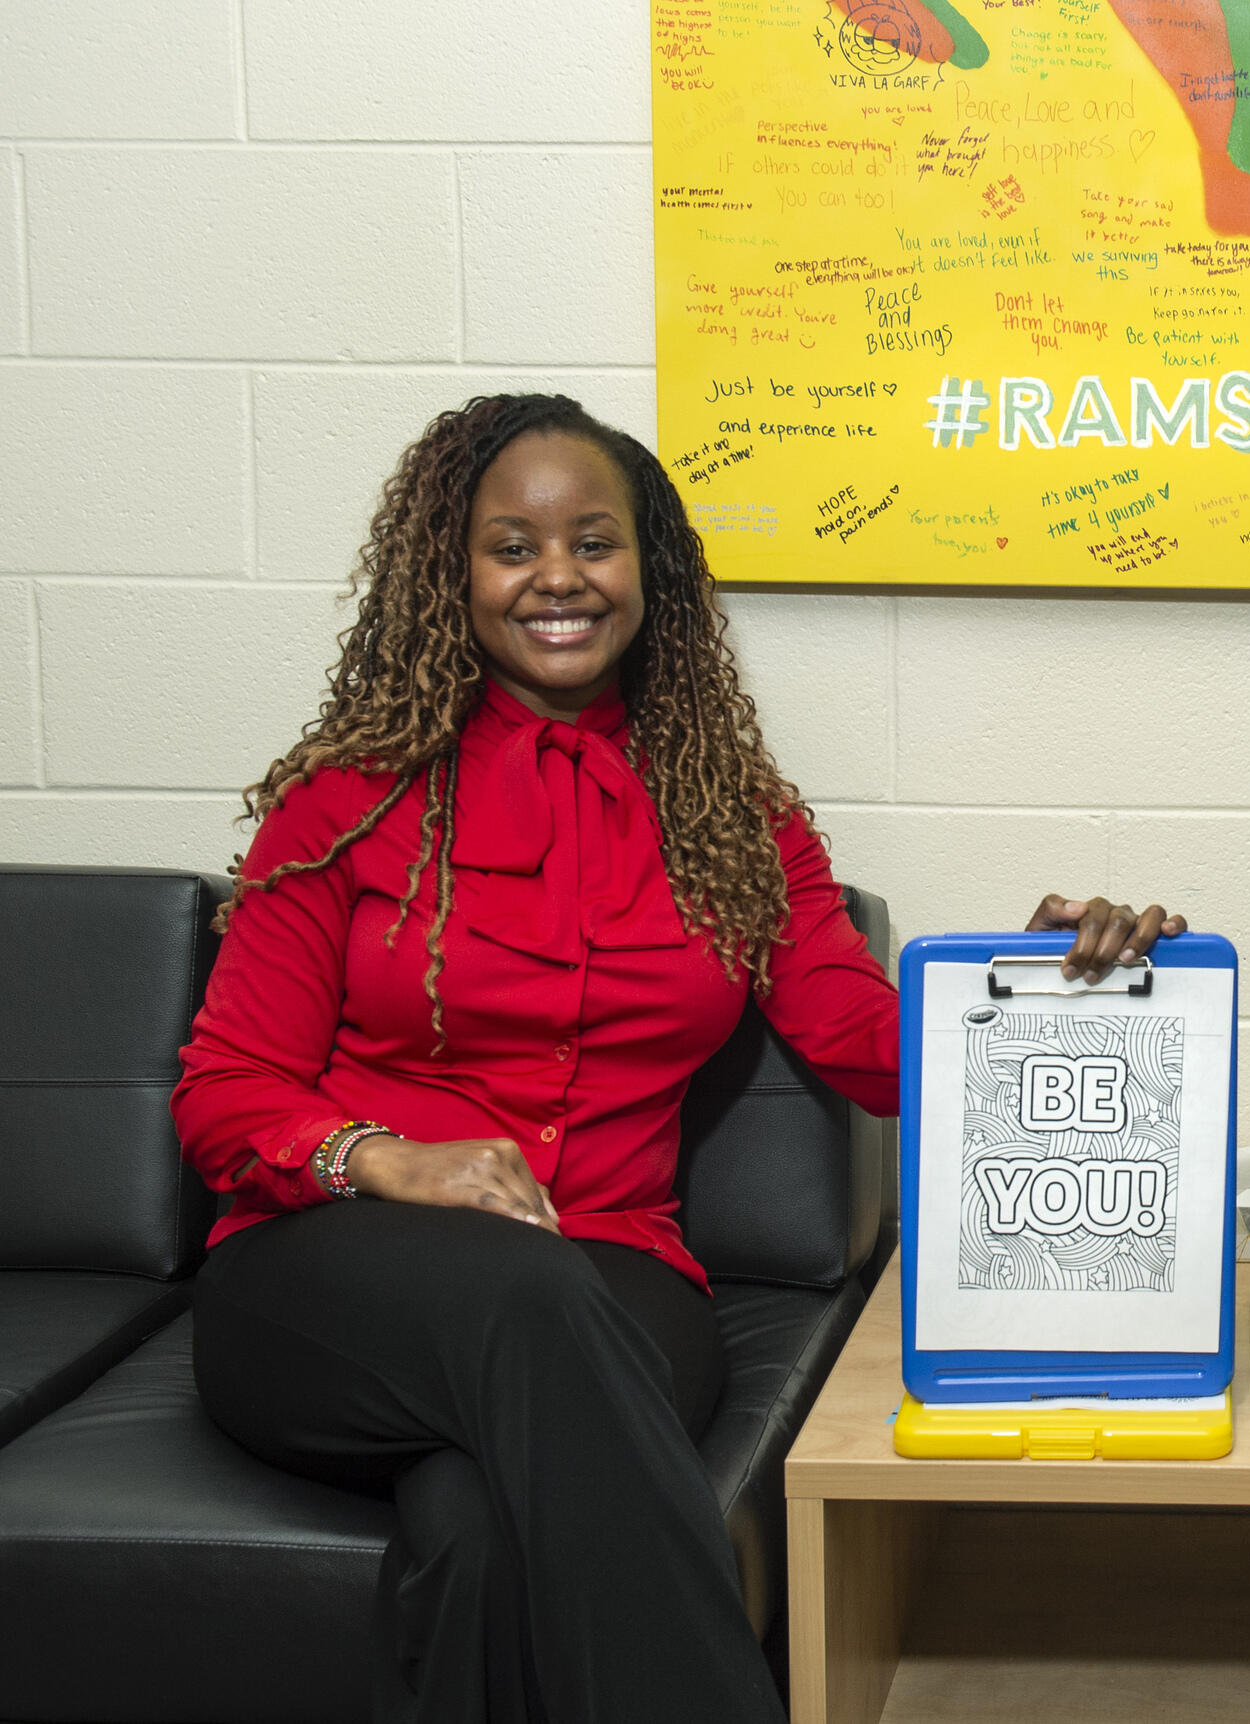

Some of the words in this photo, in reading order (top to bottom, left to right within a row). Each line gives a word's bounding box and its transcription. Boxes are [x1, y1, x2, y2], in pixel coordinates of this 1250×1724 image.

[829, 74, 866, 89] VIVA
[874, 76, 888, 90] LA
[893, 76, 931, 90] GARF
[1024, 92, 1073, 123] Love
[1083, 79, 1135, 122] and
[827, 139, 898, 162] everything!
[916, 149, 940, 159] what
[896, 227, 922, 251] You
[931, 237, 951, 248] are
[999, 234, 1025, 249] even
[1029, 227, 1040, 247] if
[1102, 251, 1158, 270] surviving
[1096, 266, 1129, 281] this
[687, 273, 717, 293] Give
[729, 282, 799, 306] yourself
[865, 282, 922, 315] Peace
[685, 304, 724, 316] more
[995, 291, 1033, 313] Dont
[1043, 292, 1064, 315] let
[878, 306, 911, 329] and
[1002, 314, 1043, 332] them
[697, 318, 737, 346] doing
[751, 328, 789, 345] great
[866, 323, 953, 357] Blessings
[1126, 326, 1148, 345] Be
[1211, 332, 1240, 345] with
[705, 375, 755, 403] Just
[770, 378, 795, 397] be
[808, 381, 876, 409] yourself
[718, 418, 751, 433] and
[759, 422, 837, 443] experience
[846, 424, 877, 438] life
[1094, 478, 1109, 492] to
[817, 485, 858, 517] HOPE
[814, 518, 845, 540] hold
[839, 516, 866, 544] pain
[867, 495, 893, 519] ends
[1088, 510, 1101, 529] 4
[1027, 1061, 1123, 1127] BE
[980, 1163, 1162, 1232] YOU!
